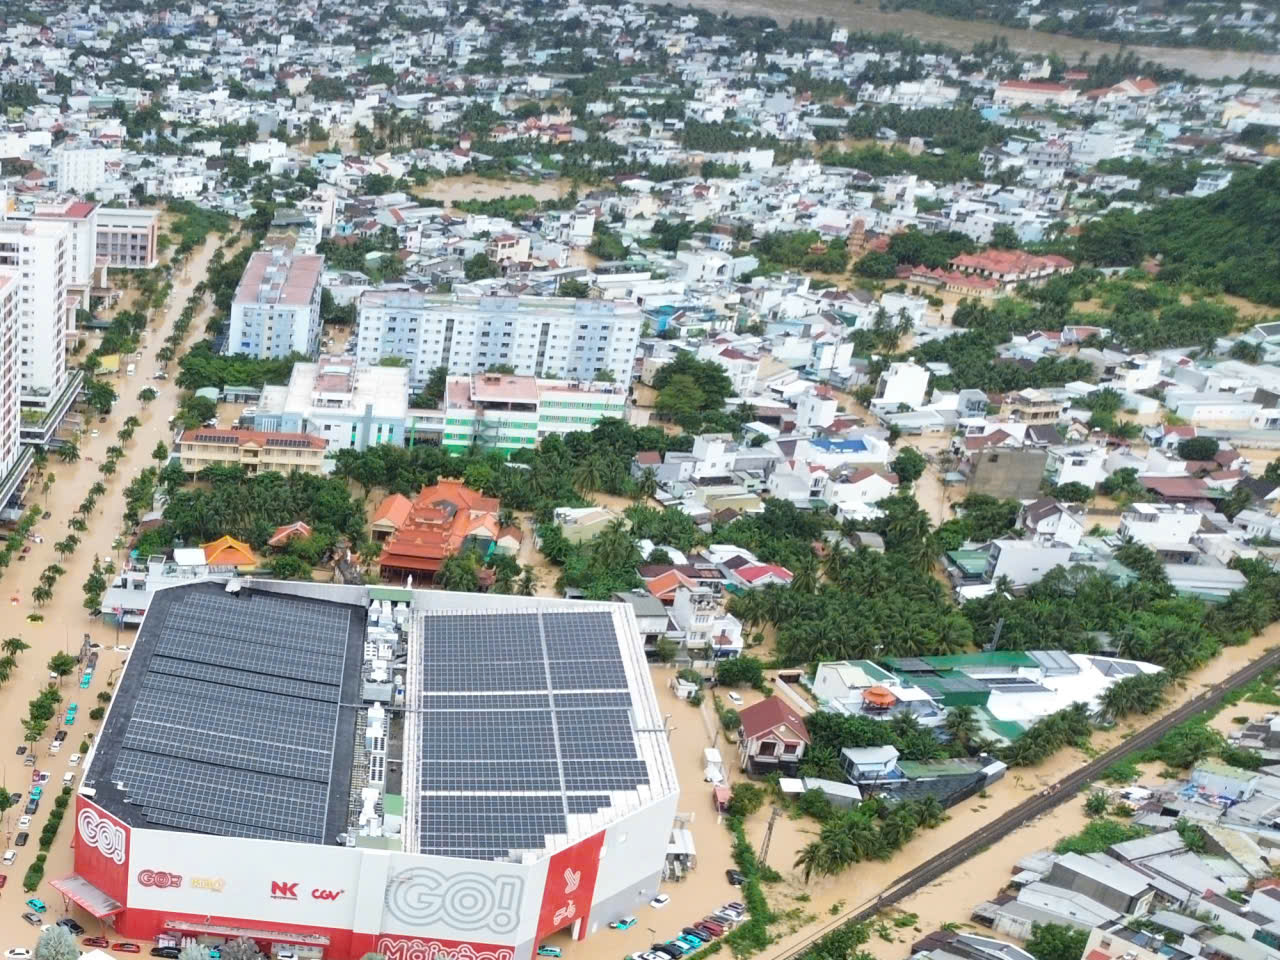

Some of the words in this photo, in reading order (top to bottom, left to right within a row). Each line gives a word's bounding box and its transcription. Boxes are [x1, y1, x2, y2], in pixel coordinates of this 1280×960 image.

[78, 808, 126, 865] GO!
[271, 880, 299, 897] NK
[311, 888, 340, 901] CGV
[387, 866, 524, 935] GO!
